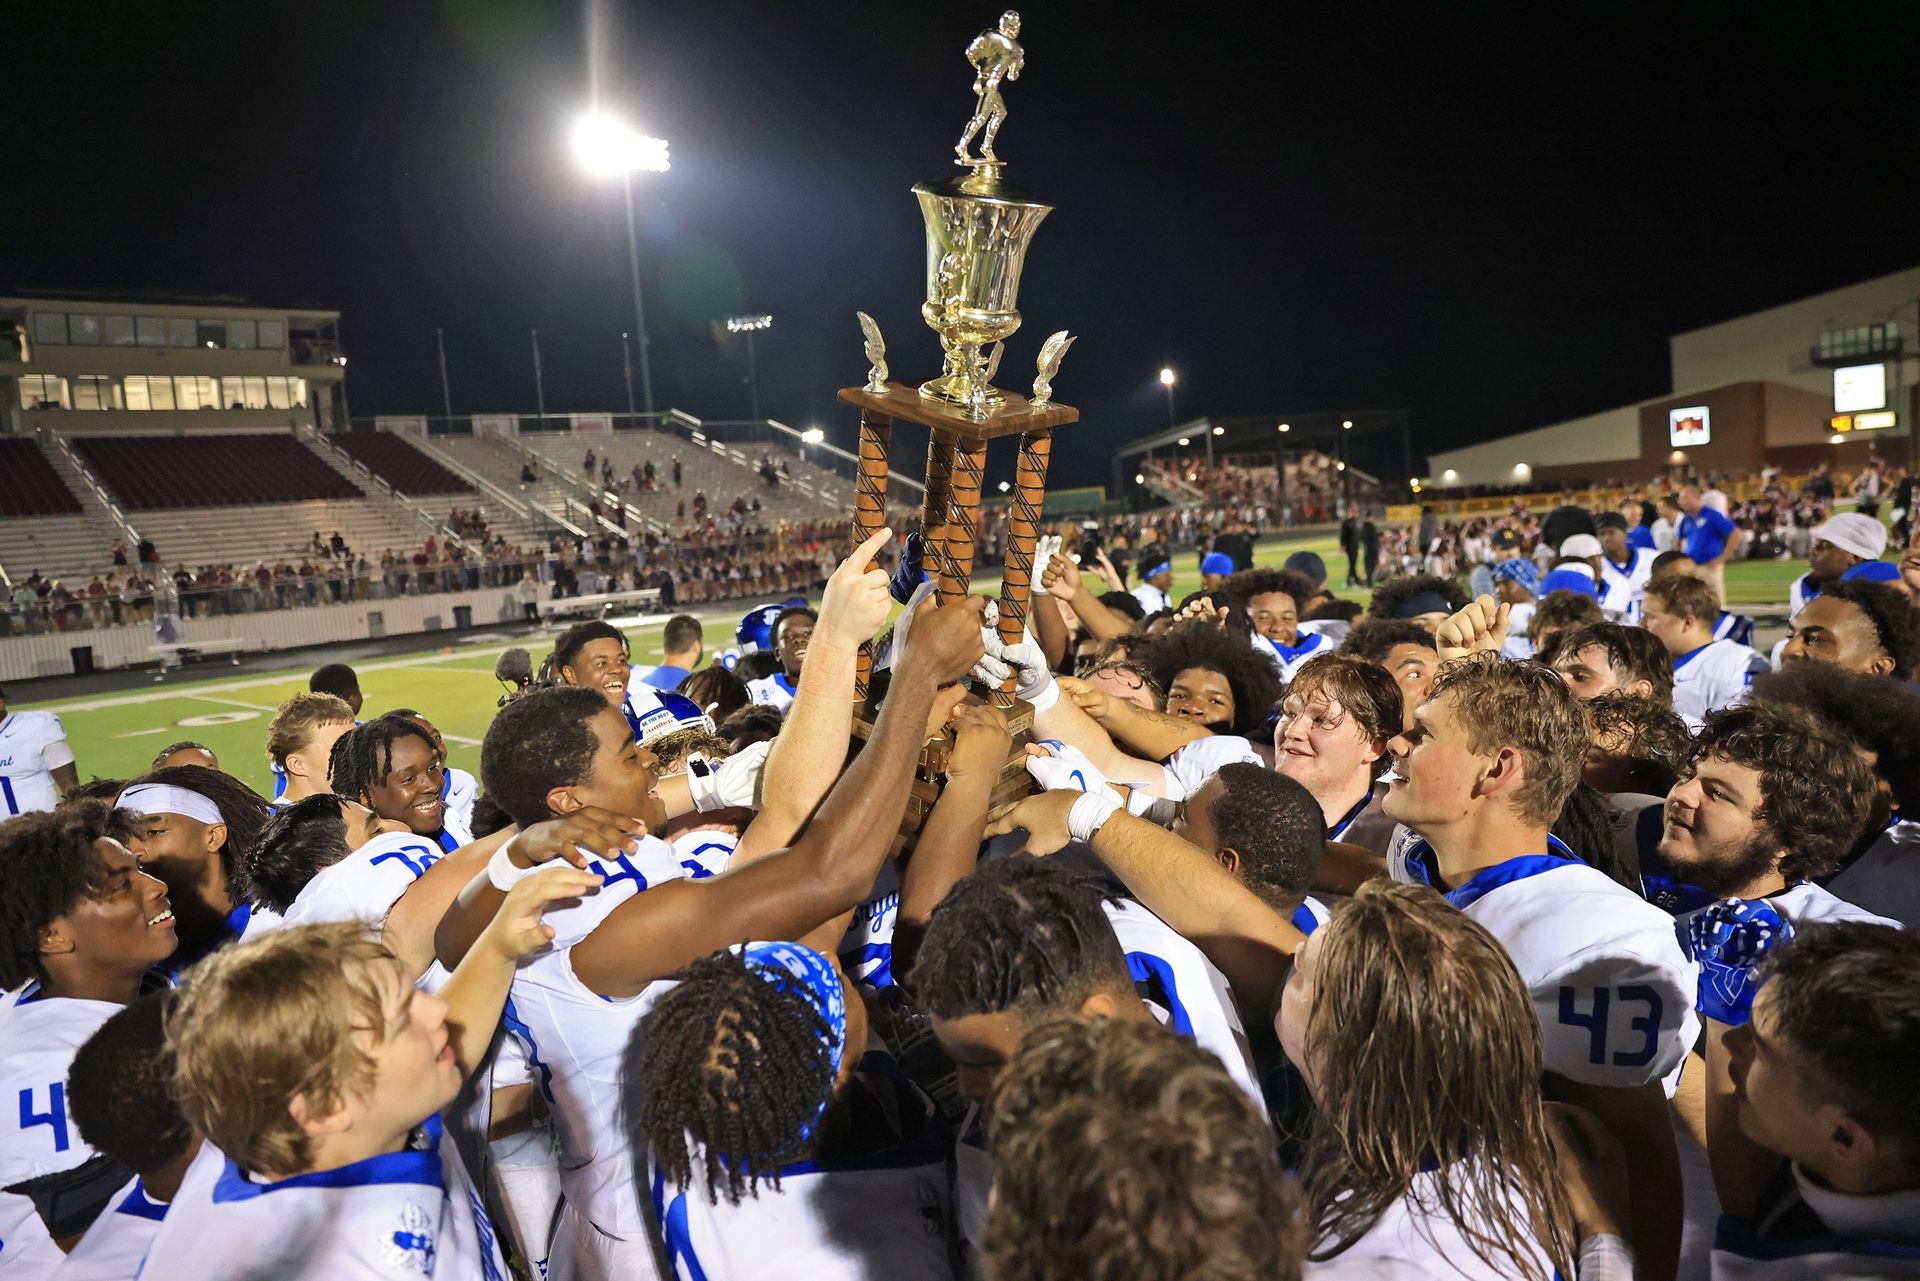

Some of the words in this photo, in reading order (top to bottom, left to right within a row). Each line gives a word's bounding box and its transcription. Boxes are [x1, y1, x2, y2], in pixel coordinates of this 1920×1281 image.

[1656, 890, 1679, 909] 212
[1559, 984, 1663, 1067] 43
[19, 1081, 69, 1153] 4
